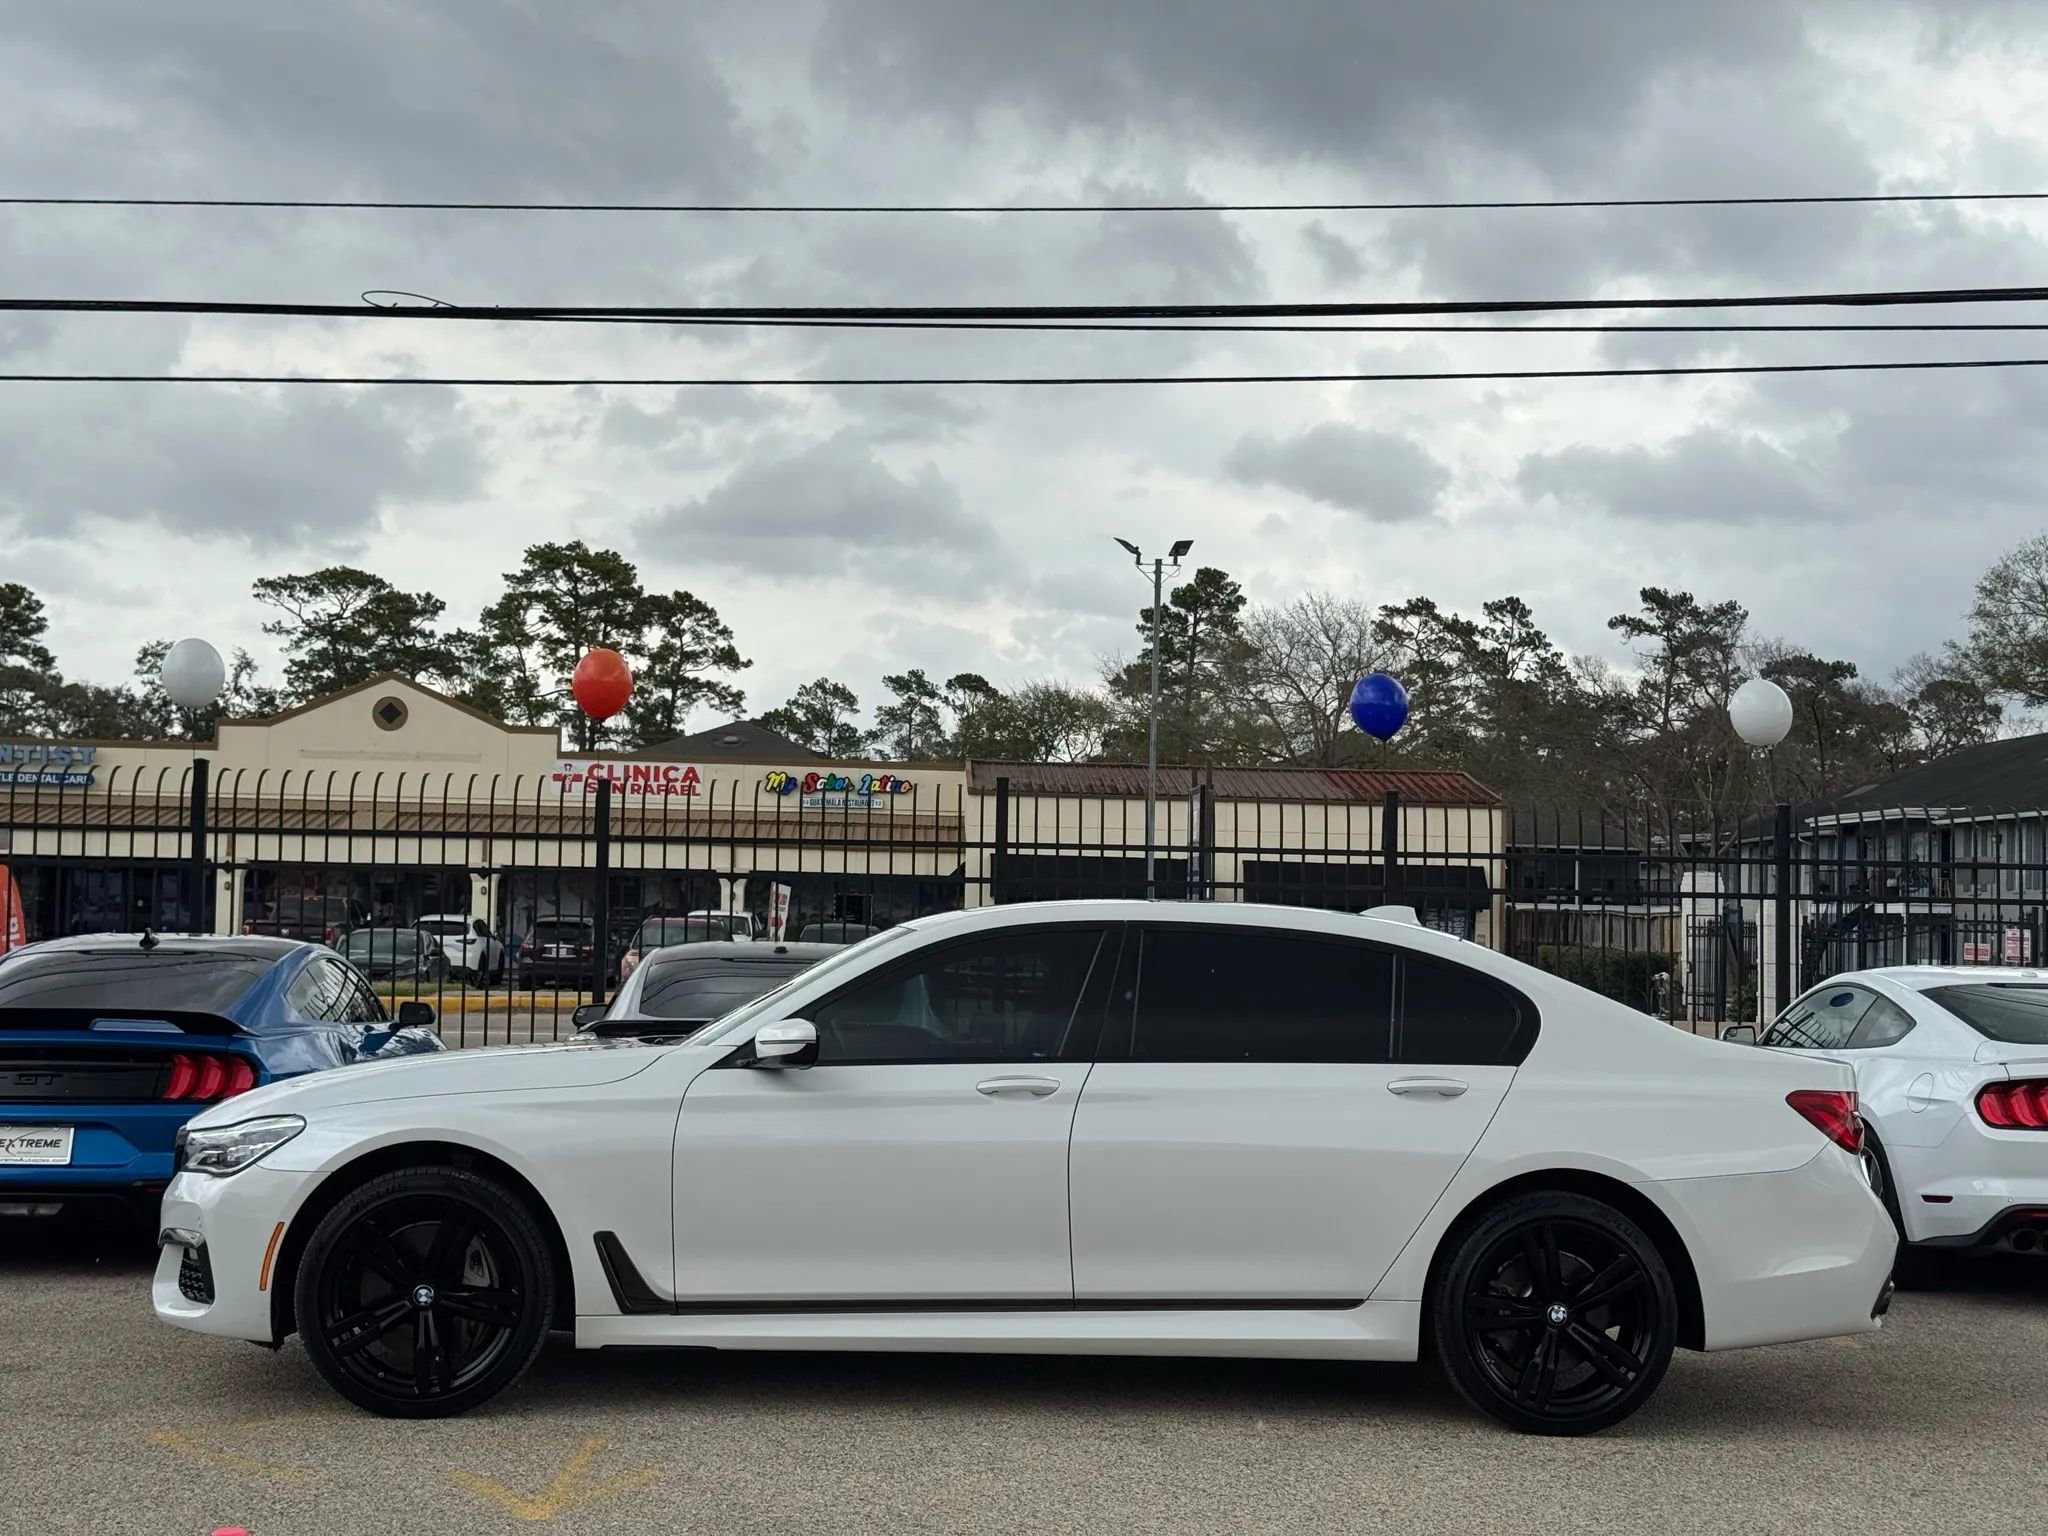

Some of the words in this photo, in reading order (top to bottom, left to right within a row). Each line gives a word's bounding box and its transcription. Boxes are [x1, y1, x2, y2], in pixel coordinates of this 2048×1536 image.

[0, 773, 14, 782] LE
[18, 773, 59, 784] DENTAL
[63, 775, 90, 784] CAR
[587, 764, 701, 783] CLINICA
[587, 782, 624, 794] SN
[630, 784, 701, 796] RAFAEL
[14, 1073, 64, 1086] GT
